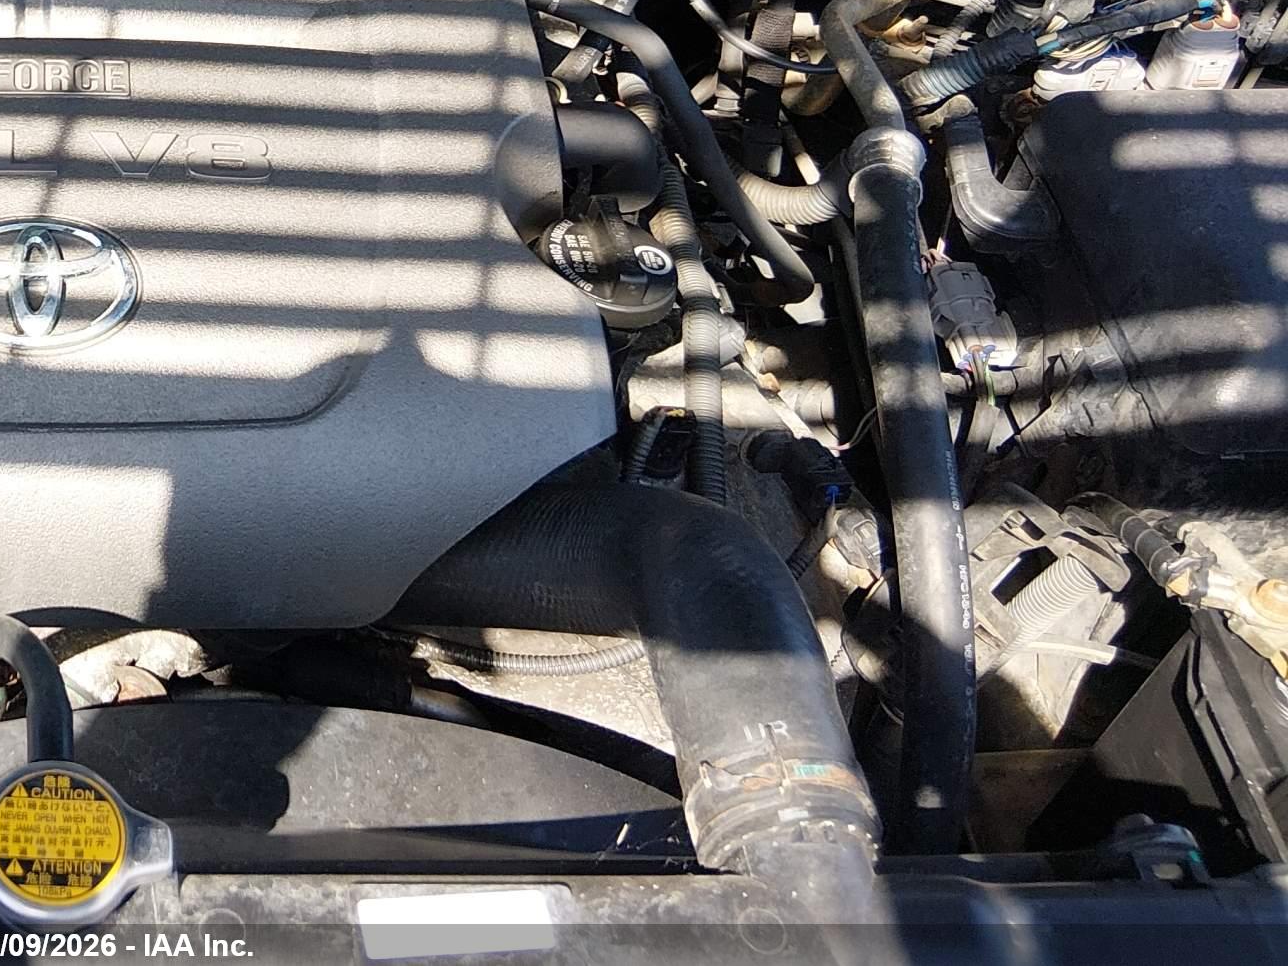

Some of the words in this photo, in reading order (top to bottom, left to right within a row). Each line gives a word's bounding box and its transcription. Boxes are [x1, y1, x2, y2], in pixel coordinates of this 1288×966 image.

[89, 131, 273, 182] V8
[549, 243, 593, 292] CONSERVING
[31, 787, 95, 800] CAUTION
[0, 811, 28, 821] NEVER
[33, 813, 56, 823] OPEN
[63, 814, 86, 824] WHEN
[32, 858, 102, 874] ATTENTION
